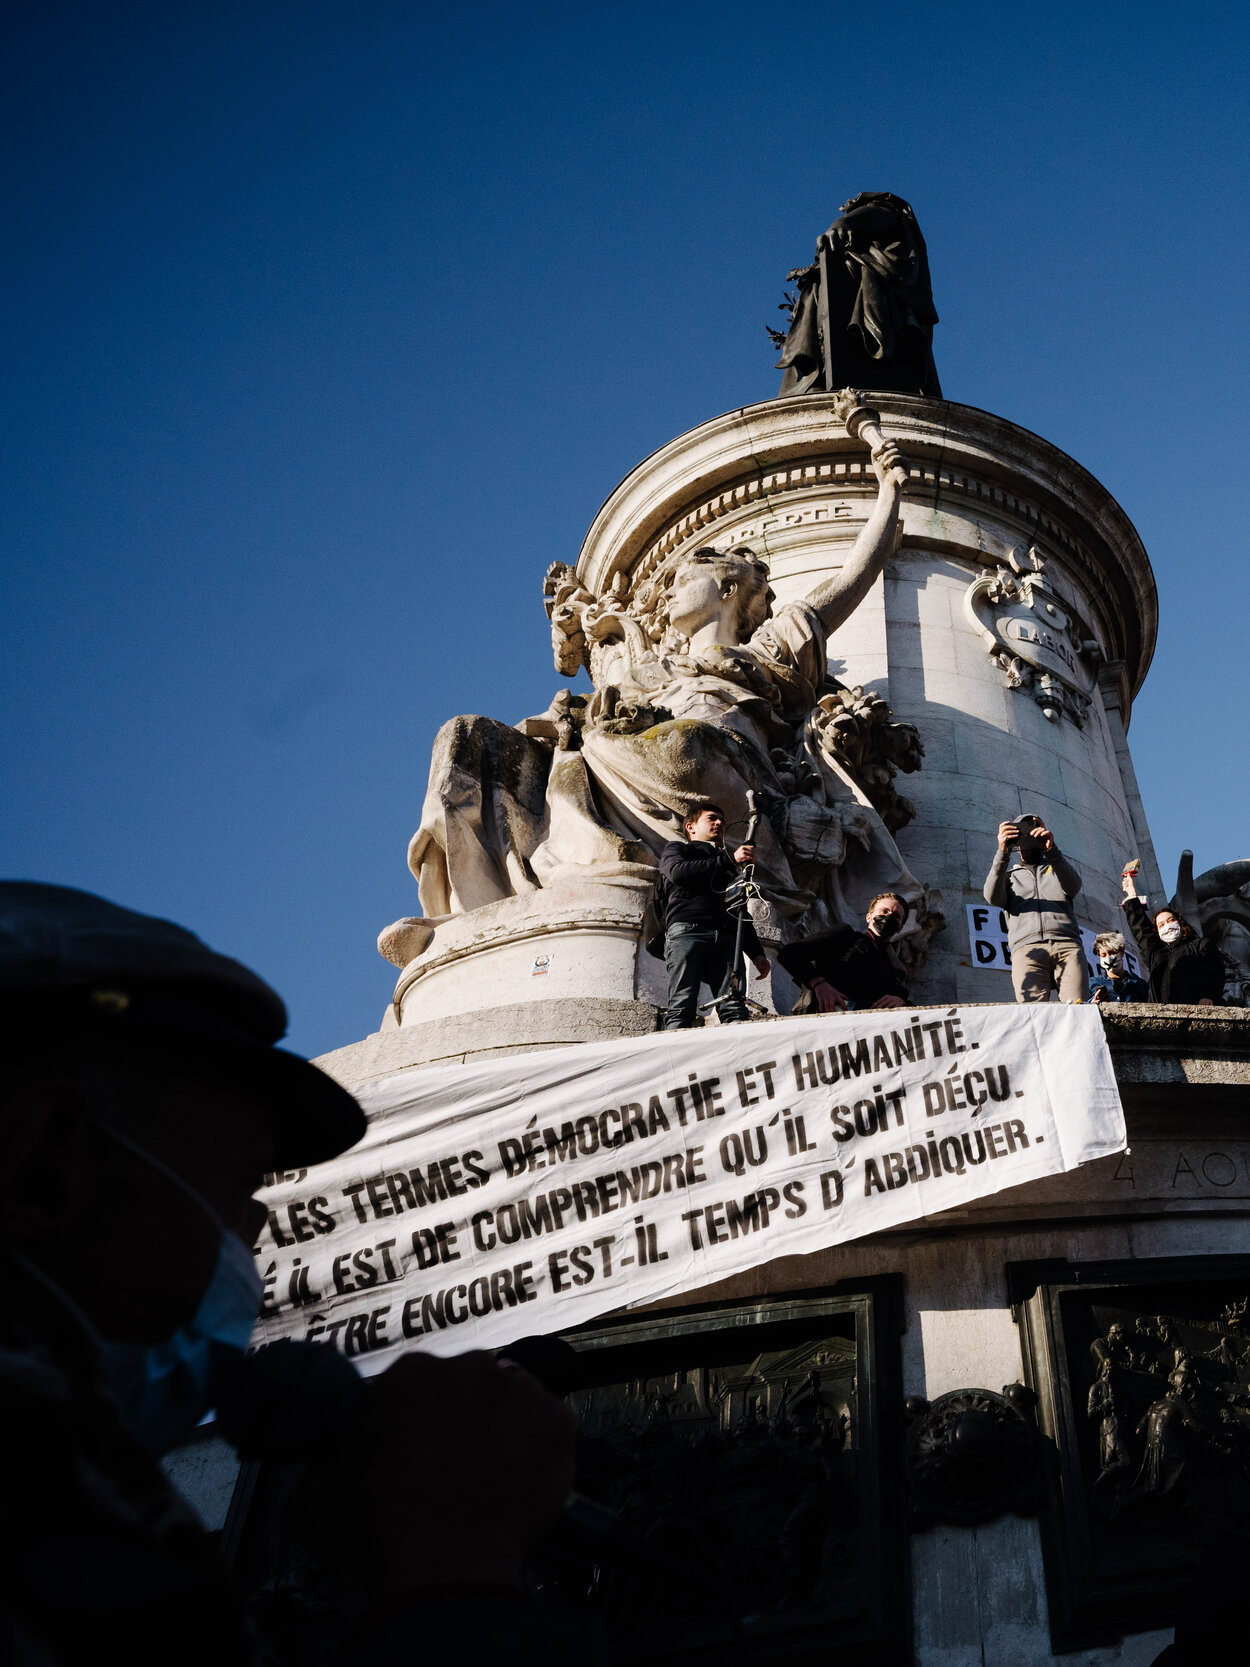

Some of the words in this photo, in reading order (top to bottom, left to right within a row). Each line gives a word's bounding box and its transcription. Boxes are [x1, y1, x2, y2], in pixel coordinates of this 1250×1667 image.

[1016, 625, 1077, 674] LABOR
[268, 1196, 336, 1248] LES
[342, 1150, 490, 1223] TERMES
[736, 1060, 776, 1108] ET
[333, 1238, 396, 1295] EST
[412, 1220, 460, 1270] DE
[471, 1145, 706, 1252] COMPRENDRE
[922, 1061, 1025, 1118] DÉÇU.
[402, 1261, 538, 1339] ENCORE
[682, 1181, 807, 1251] TEMPS
